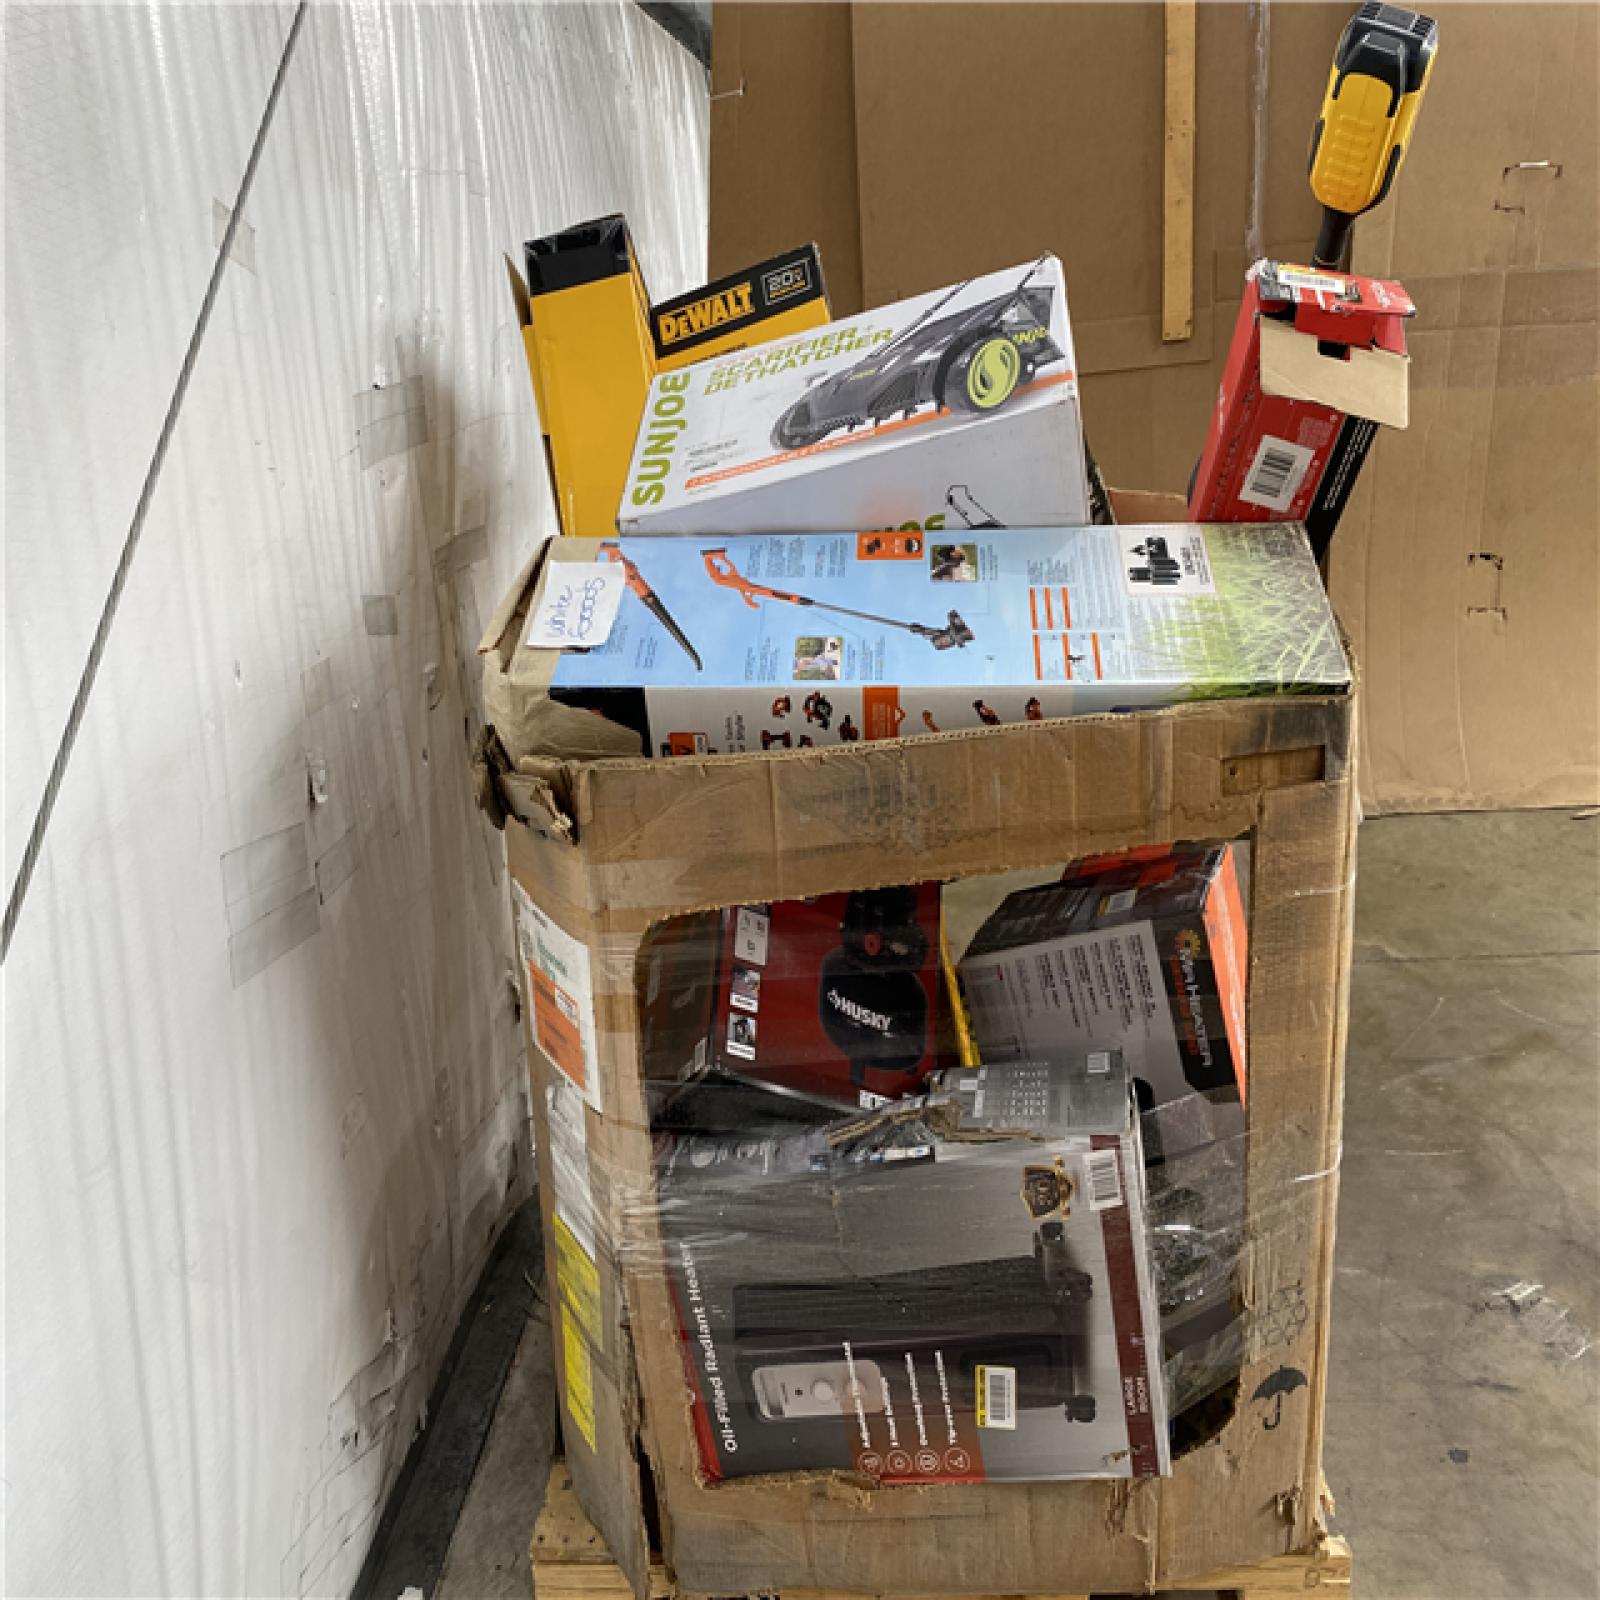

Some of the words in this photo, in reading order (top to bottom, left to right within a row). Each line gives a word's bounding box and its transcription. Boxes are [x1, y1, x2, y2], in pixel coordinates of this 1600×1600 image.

[703, 328, 894, 397] DETHATCHER
[708, 326, 859, 382] SCARIFIER
[631, 371, 692, 507] SUNJOE
[838, 996, 893, 1032] HUSKY
[691, 1305, 720, 1372] Radiant
[707, 1376, 739, 1454] Oil-Filled
